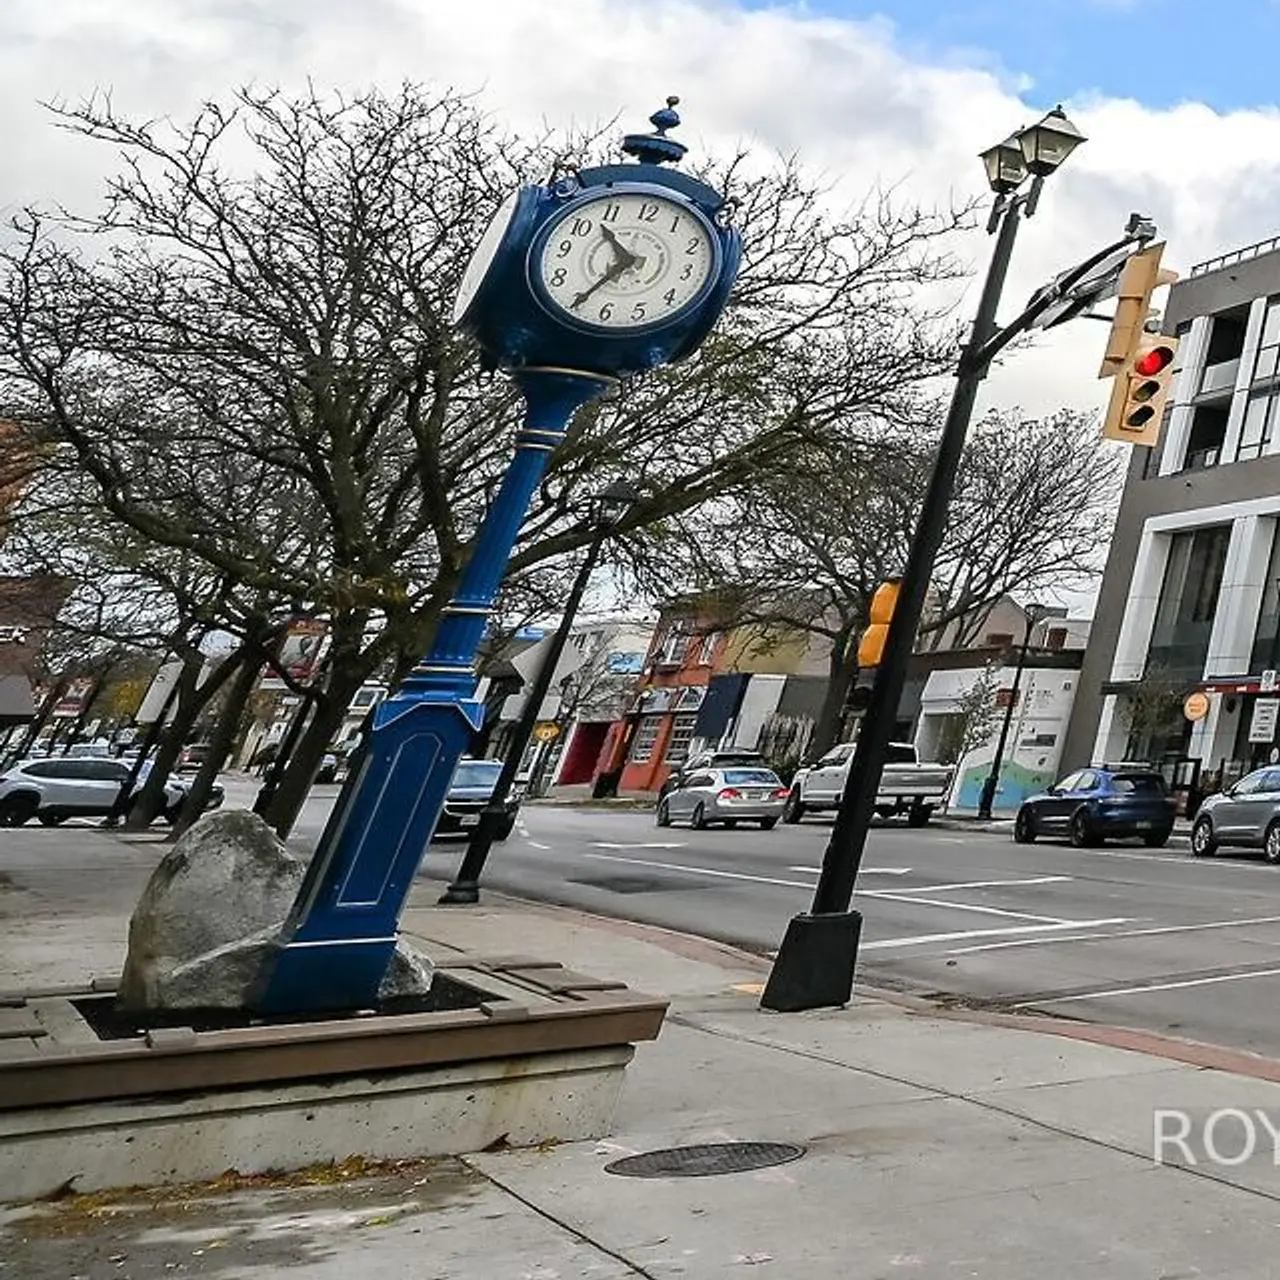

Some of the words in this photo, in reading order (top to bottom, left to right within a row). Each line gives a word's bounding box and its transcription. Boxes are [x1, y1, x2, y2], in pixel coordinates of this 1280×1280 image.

[603, 204, 620, 221] 11
[638, 203, 660, 221] 12
[569, 218, 593, 237] 10
[670, 216, 680, 233] 1
[556, 240, 572, 258] 9
[685, 238, 700, 255] 2
[550, 268, 567, 287] 8
[679, 264, 693, 281] 3
[663, 288, 677, 306] 4
[599, 302, 615, 321] 6
[630, 302, 647, 320] 5
